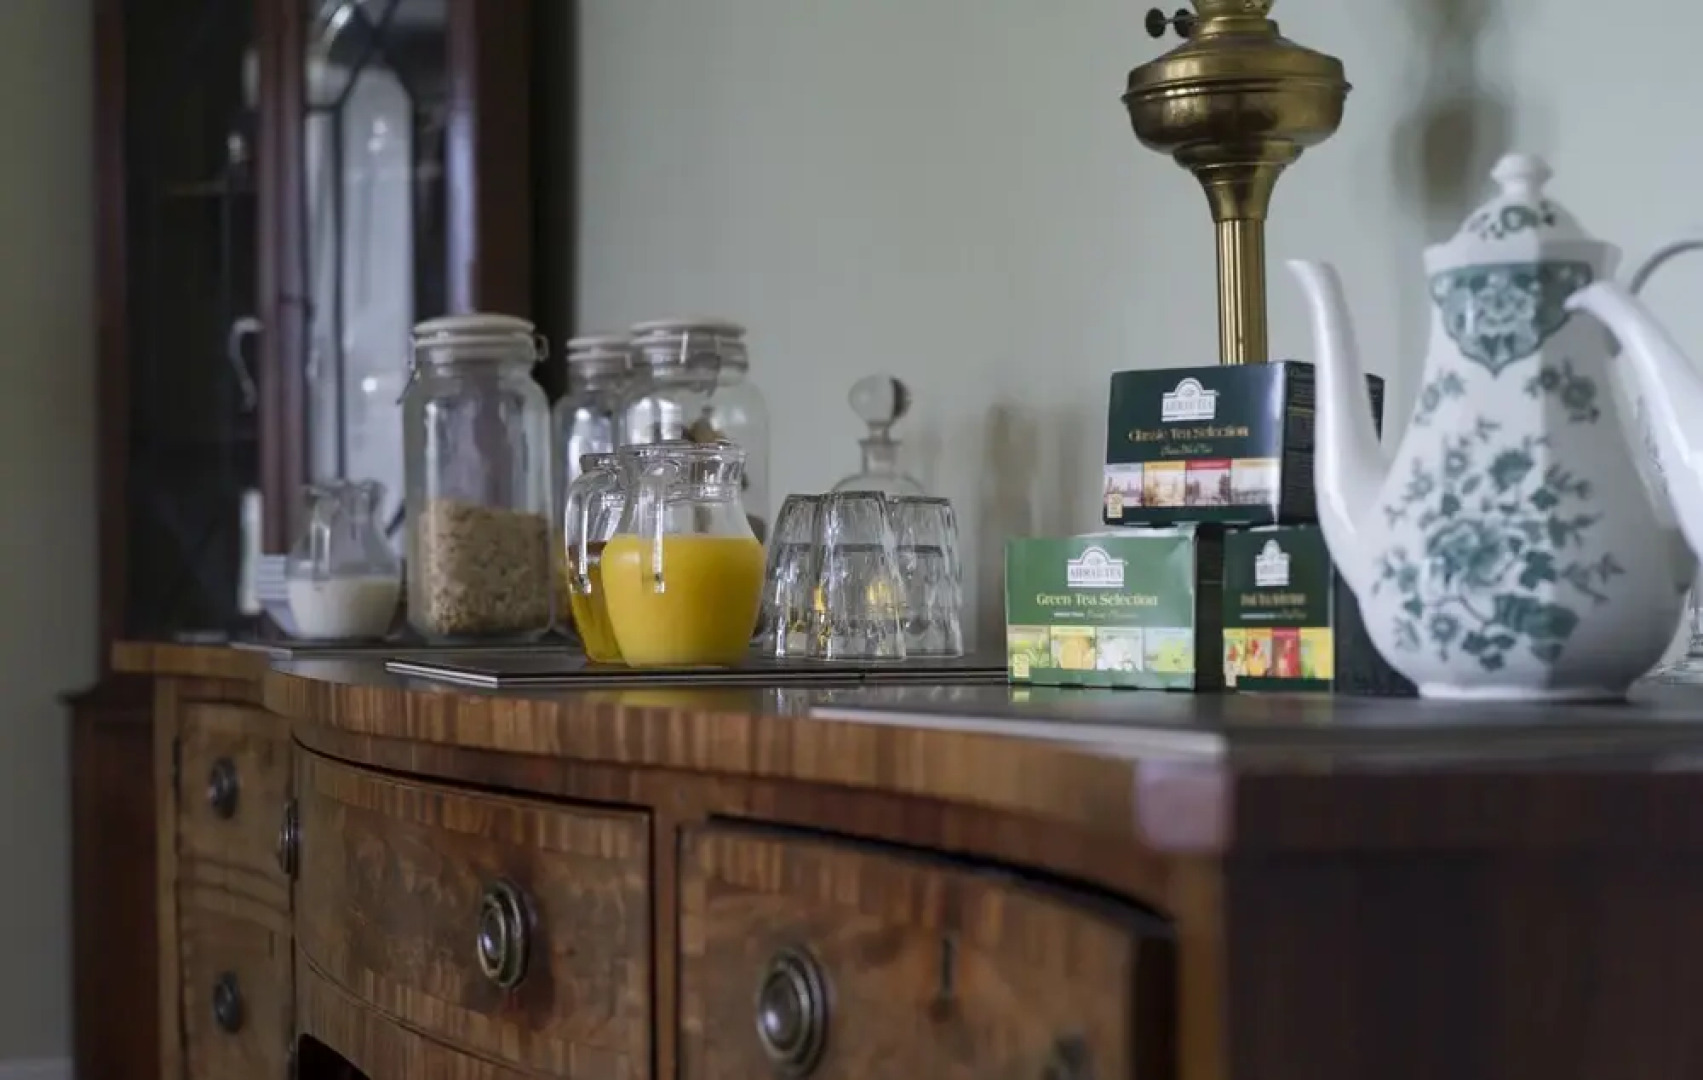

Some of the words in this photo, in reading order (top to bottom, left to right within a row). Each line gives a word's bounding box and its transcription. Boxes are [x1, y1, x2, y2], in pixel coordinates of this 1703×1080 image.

[1170, 428, 1190, 439] Tea
[1036, 593, 1071, 606] Green
[1074, 593, 1097, 606] Tea
[1099, 592, 1158, 606] Selection
